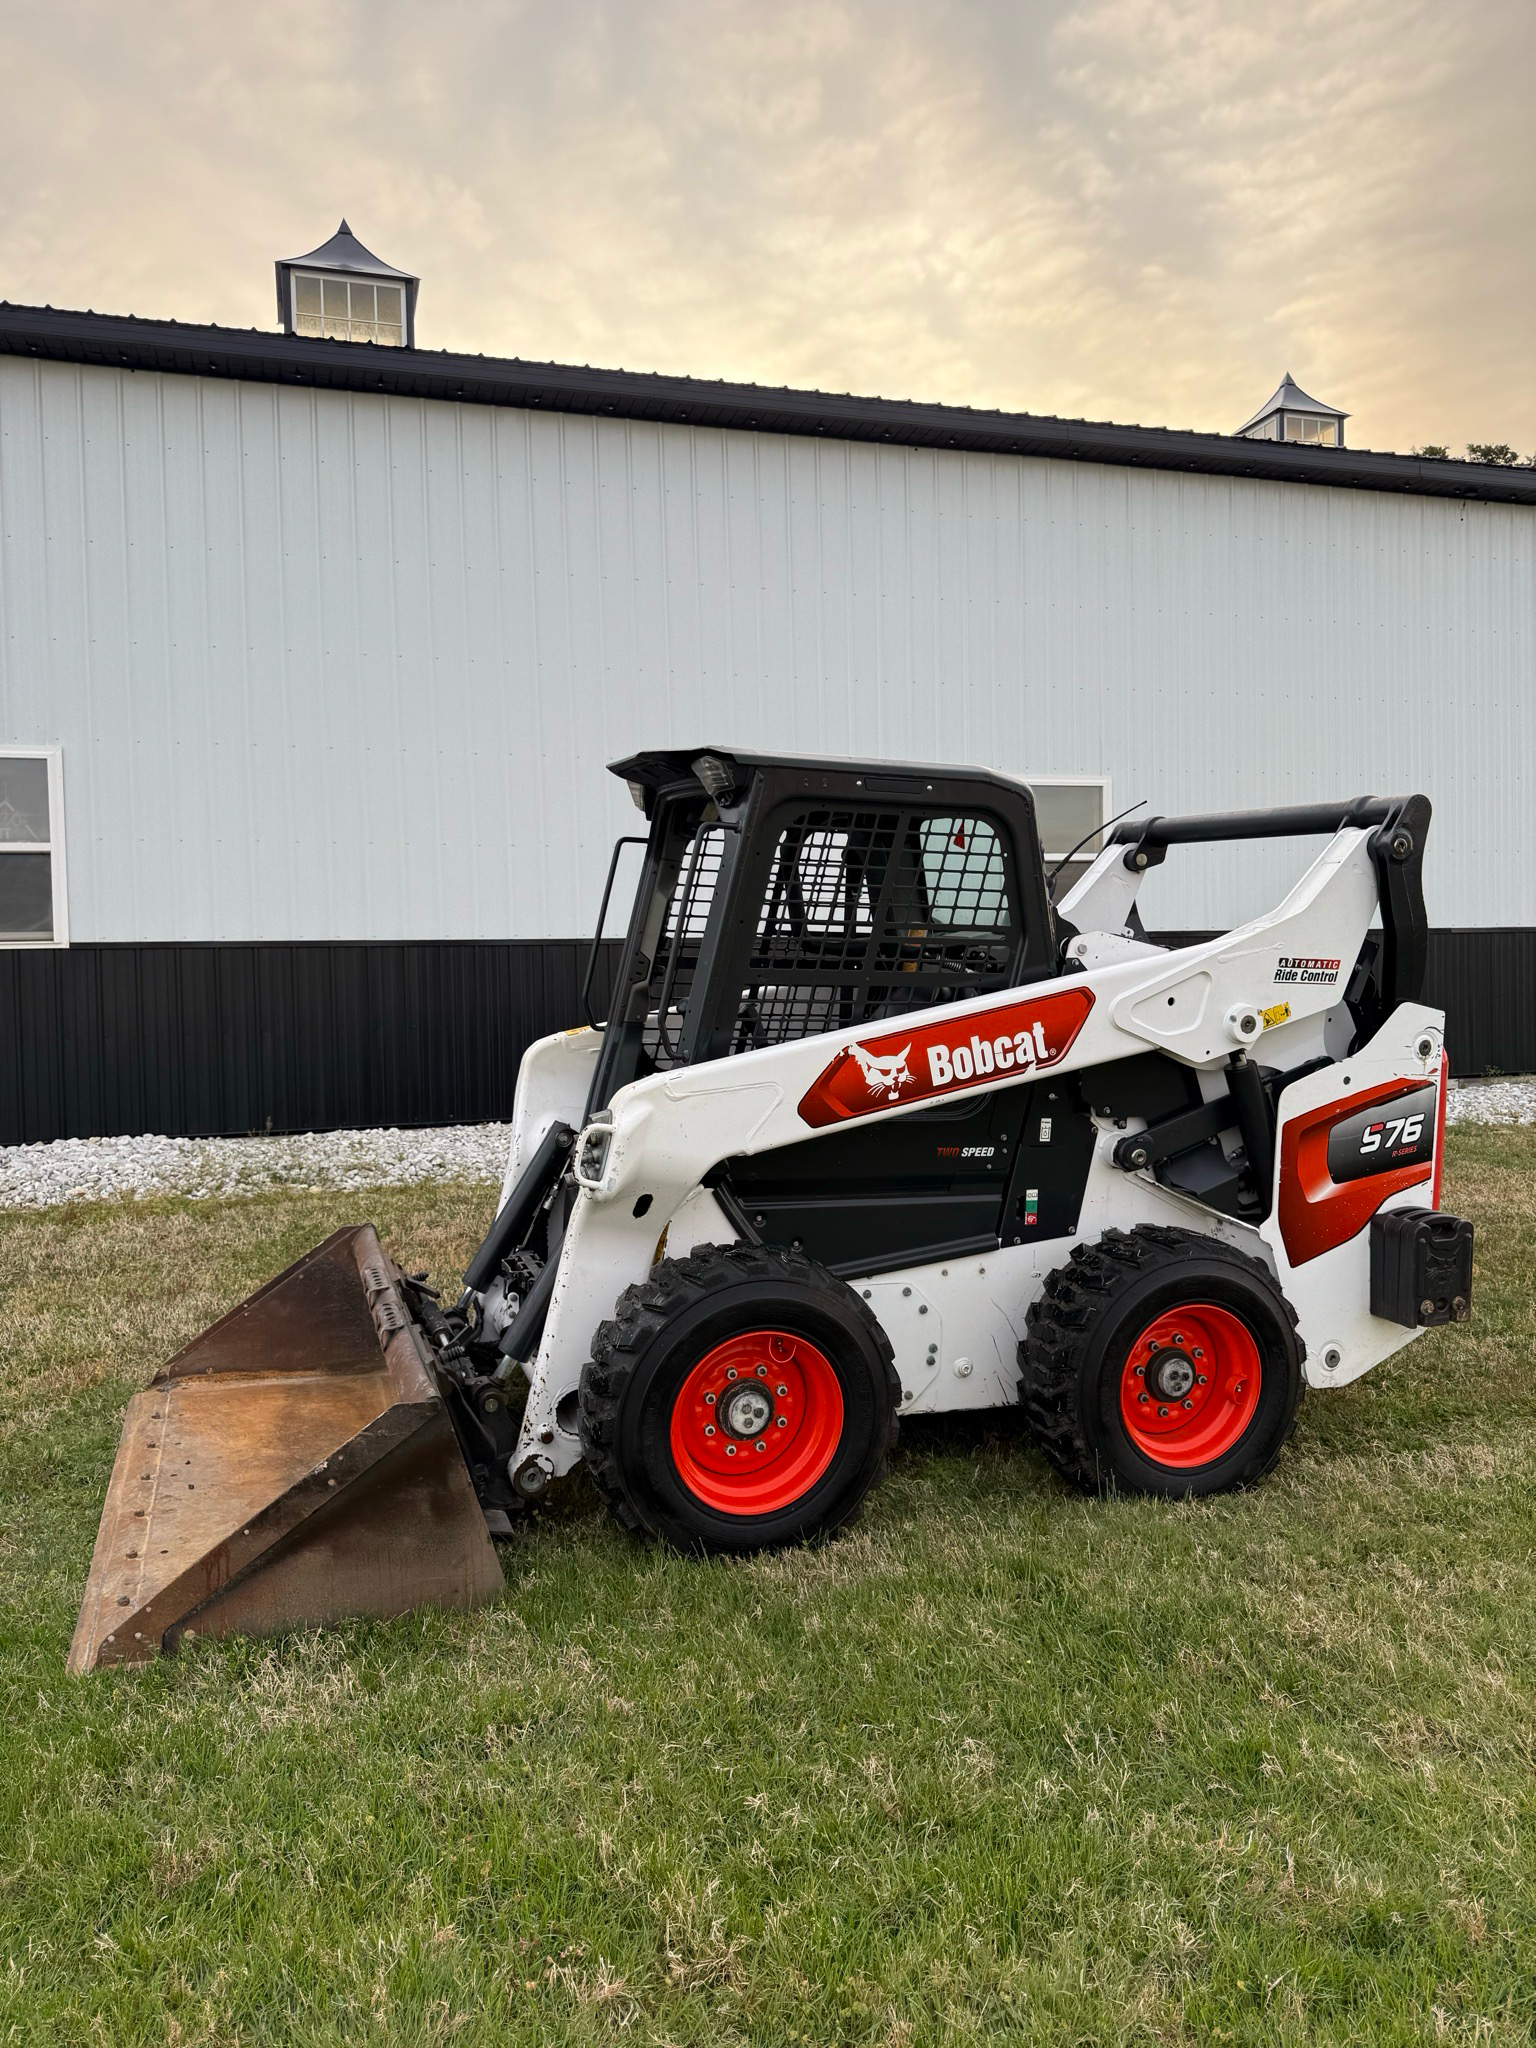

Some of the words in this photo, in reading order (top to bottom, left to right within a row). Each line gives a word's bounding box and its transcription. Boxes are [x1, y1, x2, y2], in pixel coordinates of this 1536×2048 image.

[1279, 959, 1339, 969] AUTOMATIC
[1274, 969, 1298, 981] Ride
[1300, 970, 1338, 982] Control
[927, 1021, 1049, 1086] Bobcat
[1359, 1112, 1426, 1154] S76
[936, 1147, 960, 1157] TWO
[961, 1147, 994, 1157] SPEED
